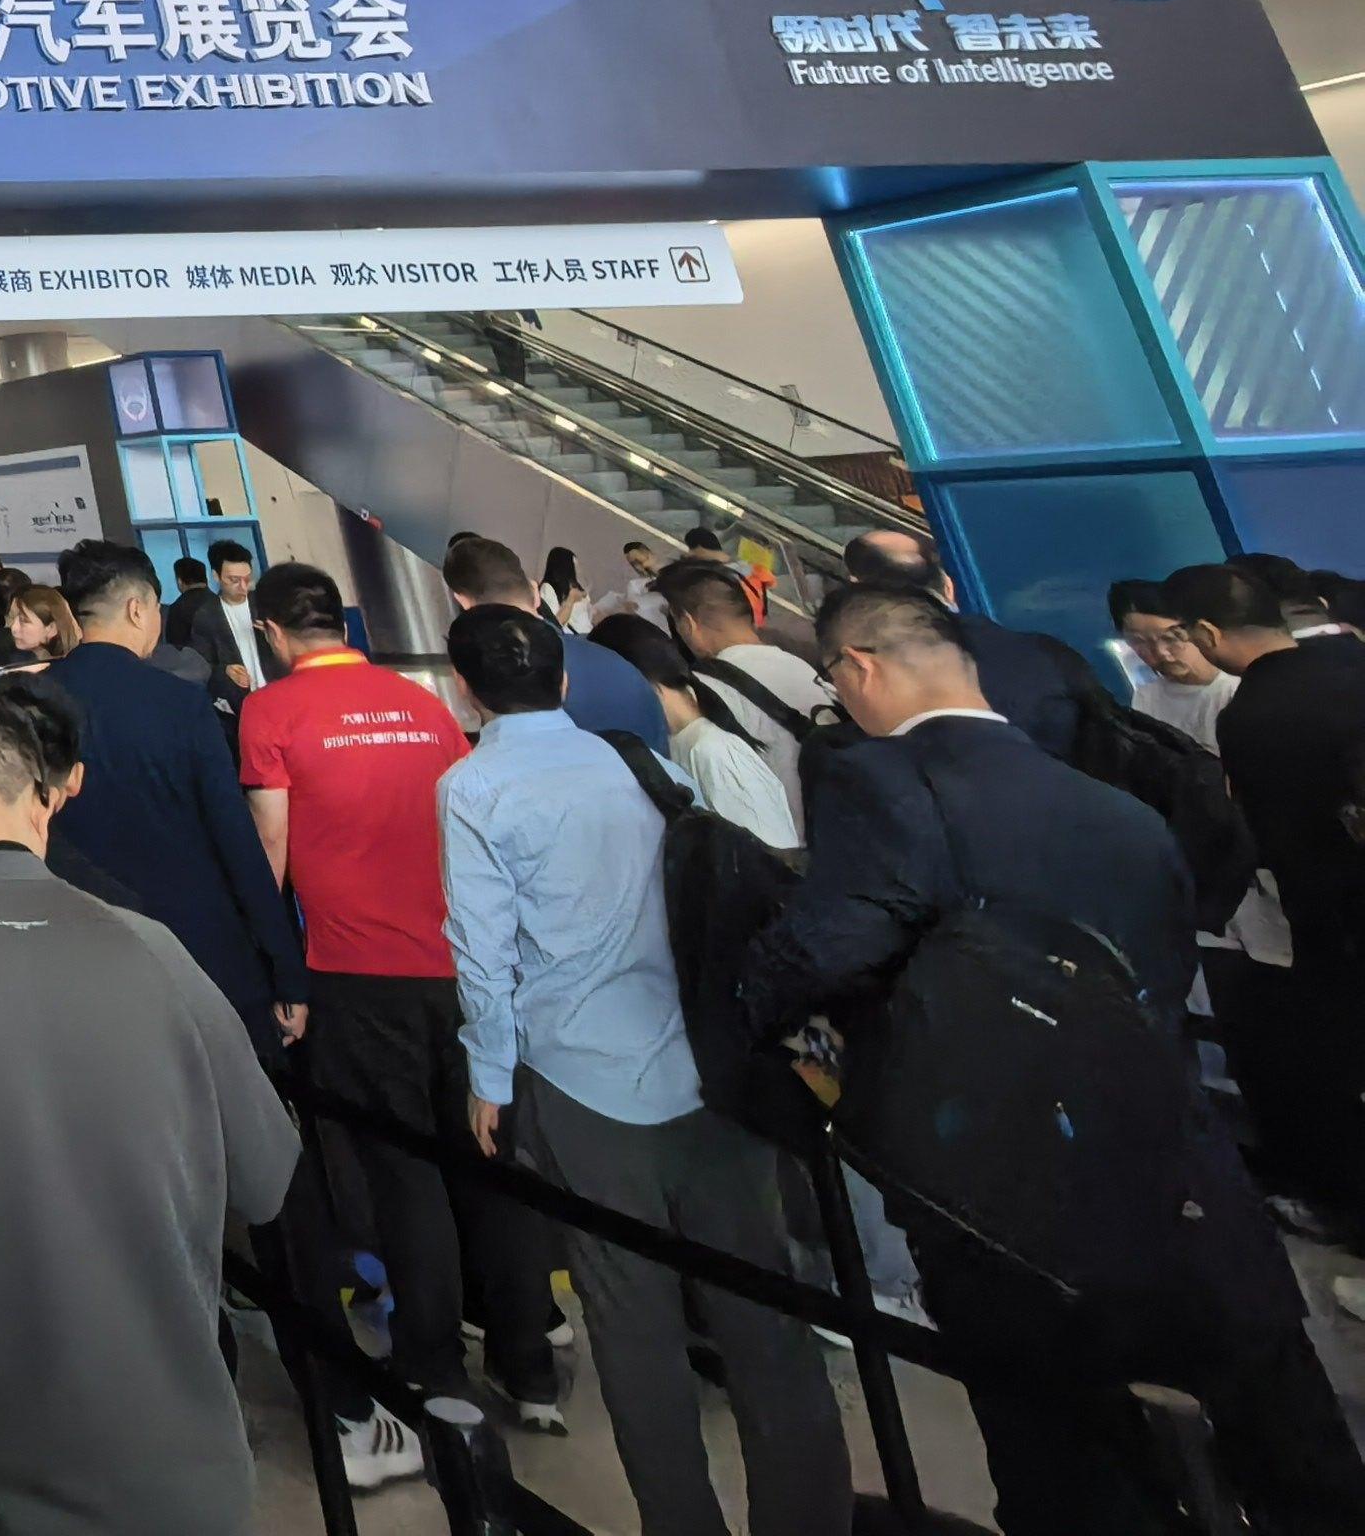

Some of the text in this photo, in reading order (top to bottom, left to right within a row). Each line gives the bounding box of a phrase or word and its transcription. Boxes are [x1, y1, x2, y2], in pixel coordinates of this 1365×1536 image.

[945, 11, 1105, 54] 智未来
[135, 69, 435, 112] EXHIBITION
[787, 56, 1116, 89] Future of Intelligence
[39, 267, 170, 292] EXHIBITOR
[185, 264, 234, 291] 媒体
[240, 265, 316, 288] MEDIA
[329, 261, 380, 288] 观众
[381, 261, 478, 286] VISITOR
[494, 257, 588, 284] 工作人员
[592, 257, 660, 281] STAFF
